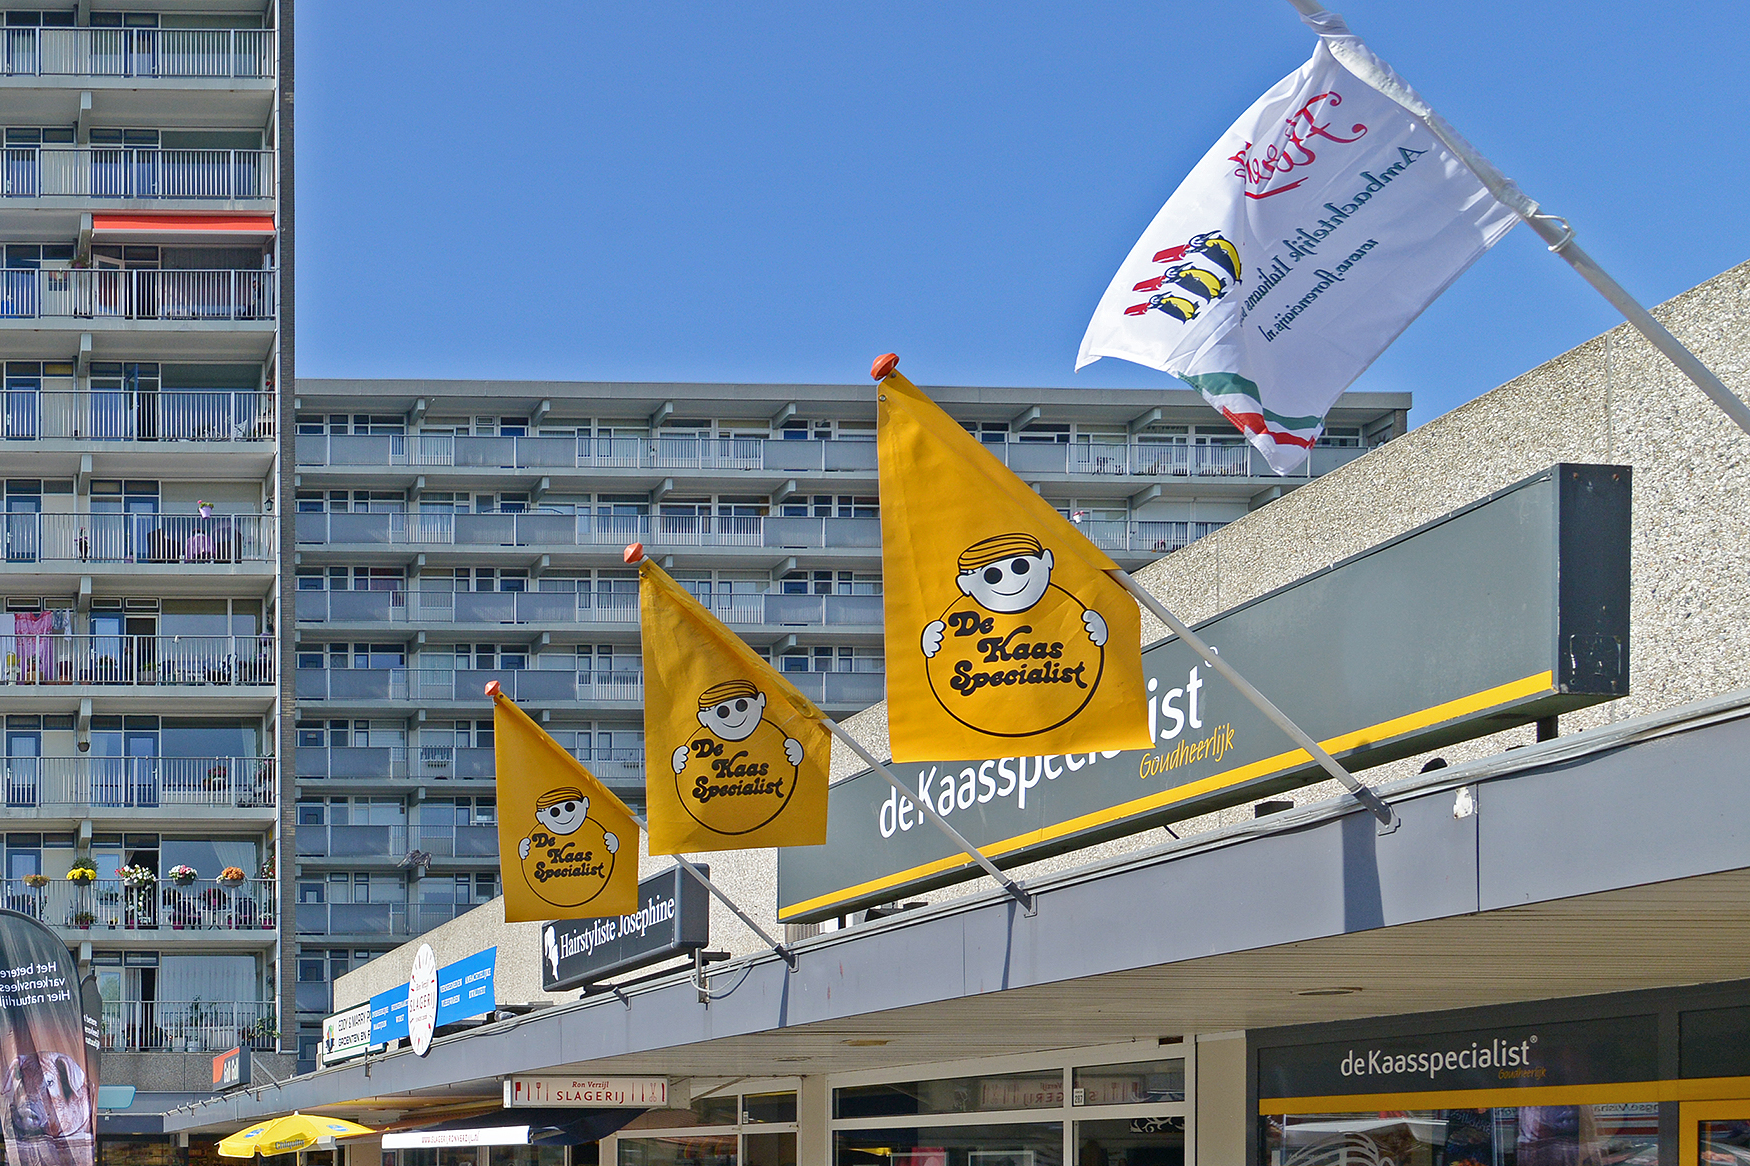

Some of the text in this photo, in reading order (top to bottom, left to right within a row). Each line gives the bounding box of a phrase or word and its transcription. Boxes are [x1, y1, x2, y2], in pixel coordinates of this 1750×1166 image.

[950, 612, 994, 637] De
[977, 626, 1064, 663] Kaas
[950, 661, 1088, 696] Specialist
[691, 738, 723, 758] De
[1139, 723, 1235, 780] Goudheerlijk
[711, 751, 769, 778] Kaas
[692, 776, 784, 803] Specialist
[532, 832, 556, 848] De
[548, 842, 592, 863] Kaas
[534, 861, 606, 883] Specialist
[560, 894, 675, 960] Hairstyliste Josephine
[1340, 1038, 1530, 1079] deKaasspecialist
[556, 1091, 625, 1104] SLAGERIJ
[587, 1080, 610, 1089] Verzijl
